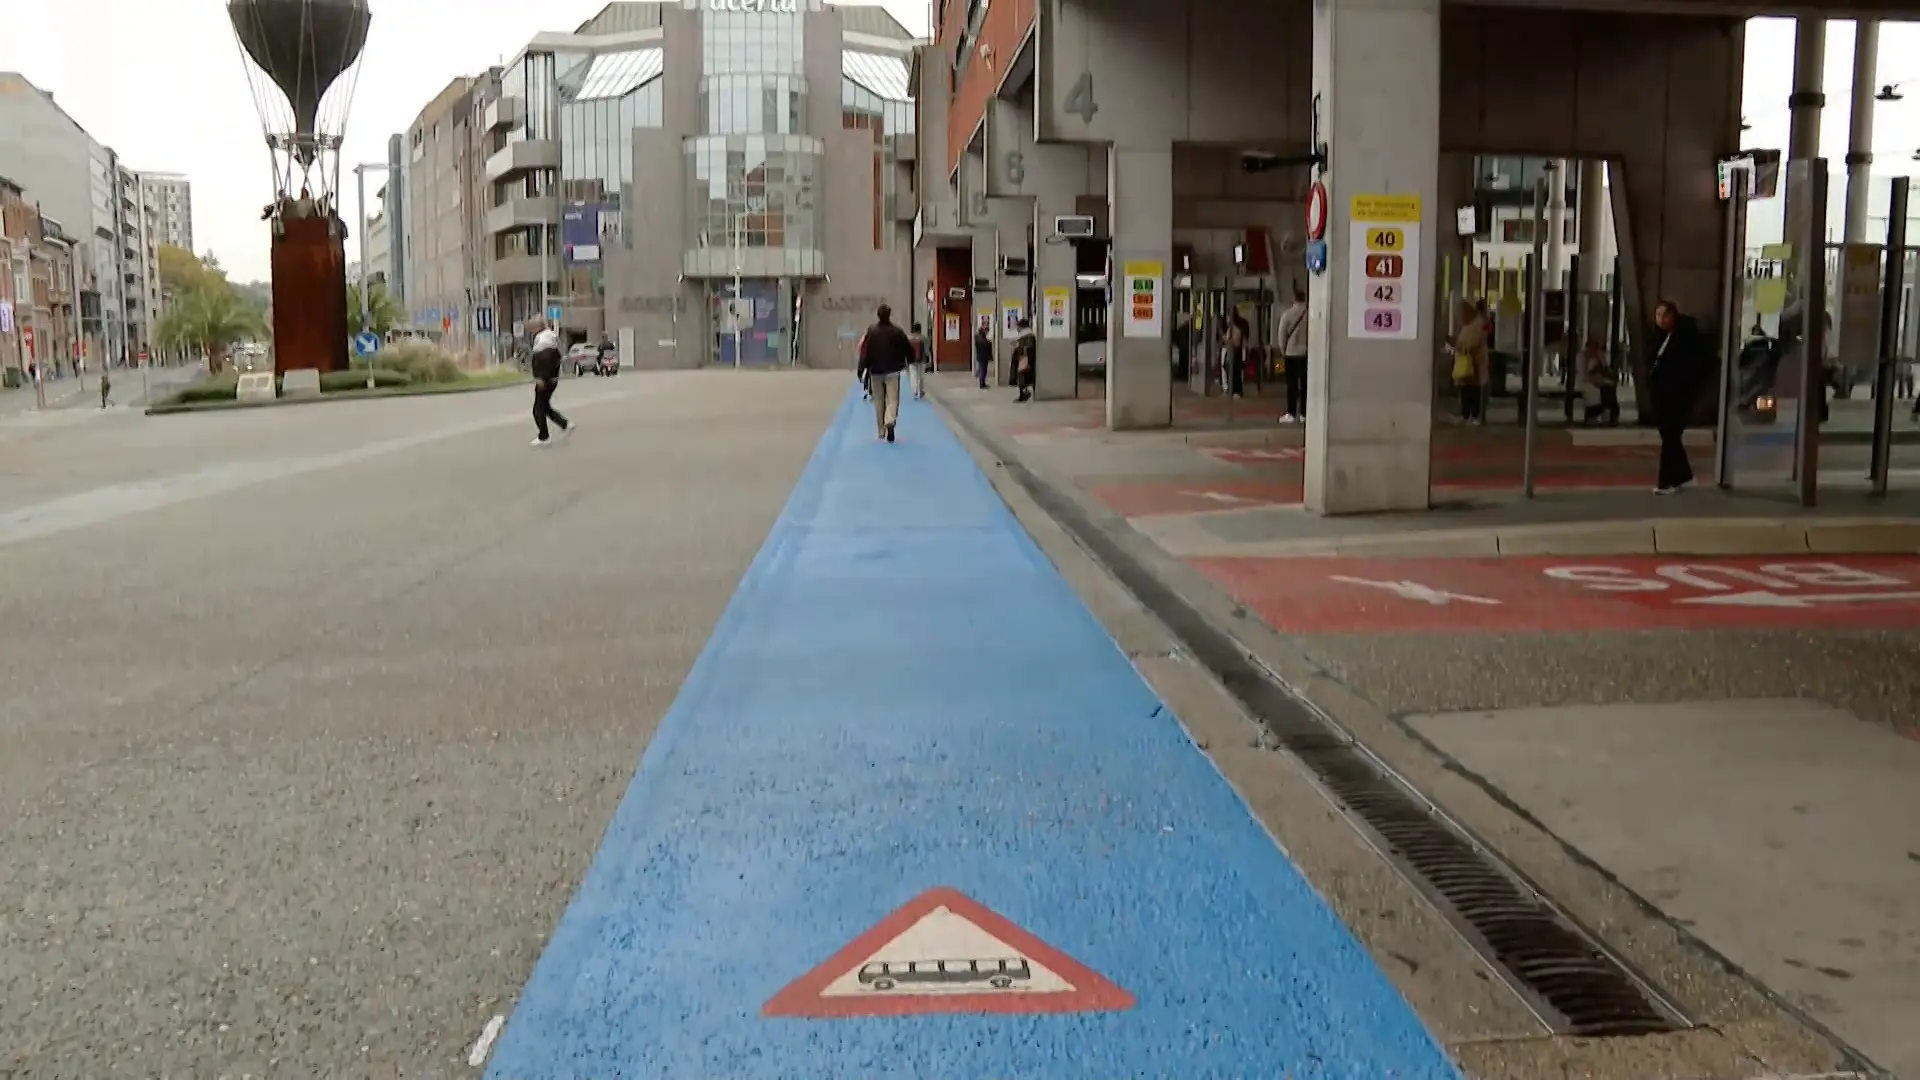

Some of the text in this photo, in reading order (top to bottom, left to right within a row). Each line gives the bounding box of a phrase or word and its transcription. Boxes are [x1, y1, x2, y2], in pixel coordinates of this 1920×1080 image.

[1063, 71, 1099, 125] 4
[1374, 231, 1396, 248] 40
[1375, 257, 1394, 276] 41
[1373, 285, 1394, 302] 42
[1373, 312, 1394, 329] 43
[1543, 562, 1911, 591] BUS
